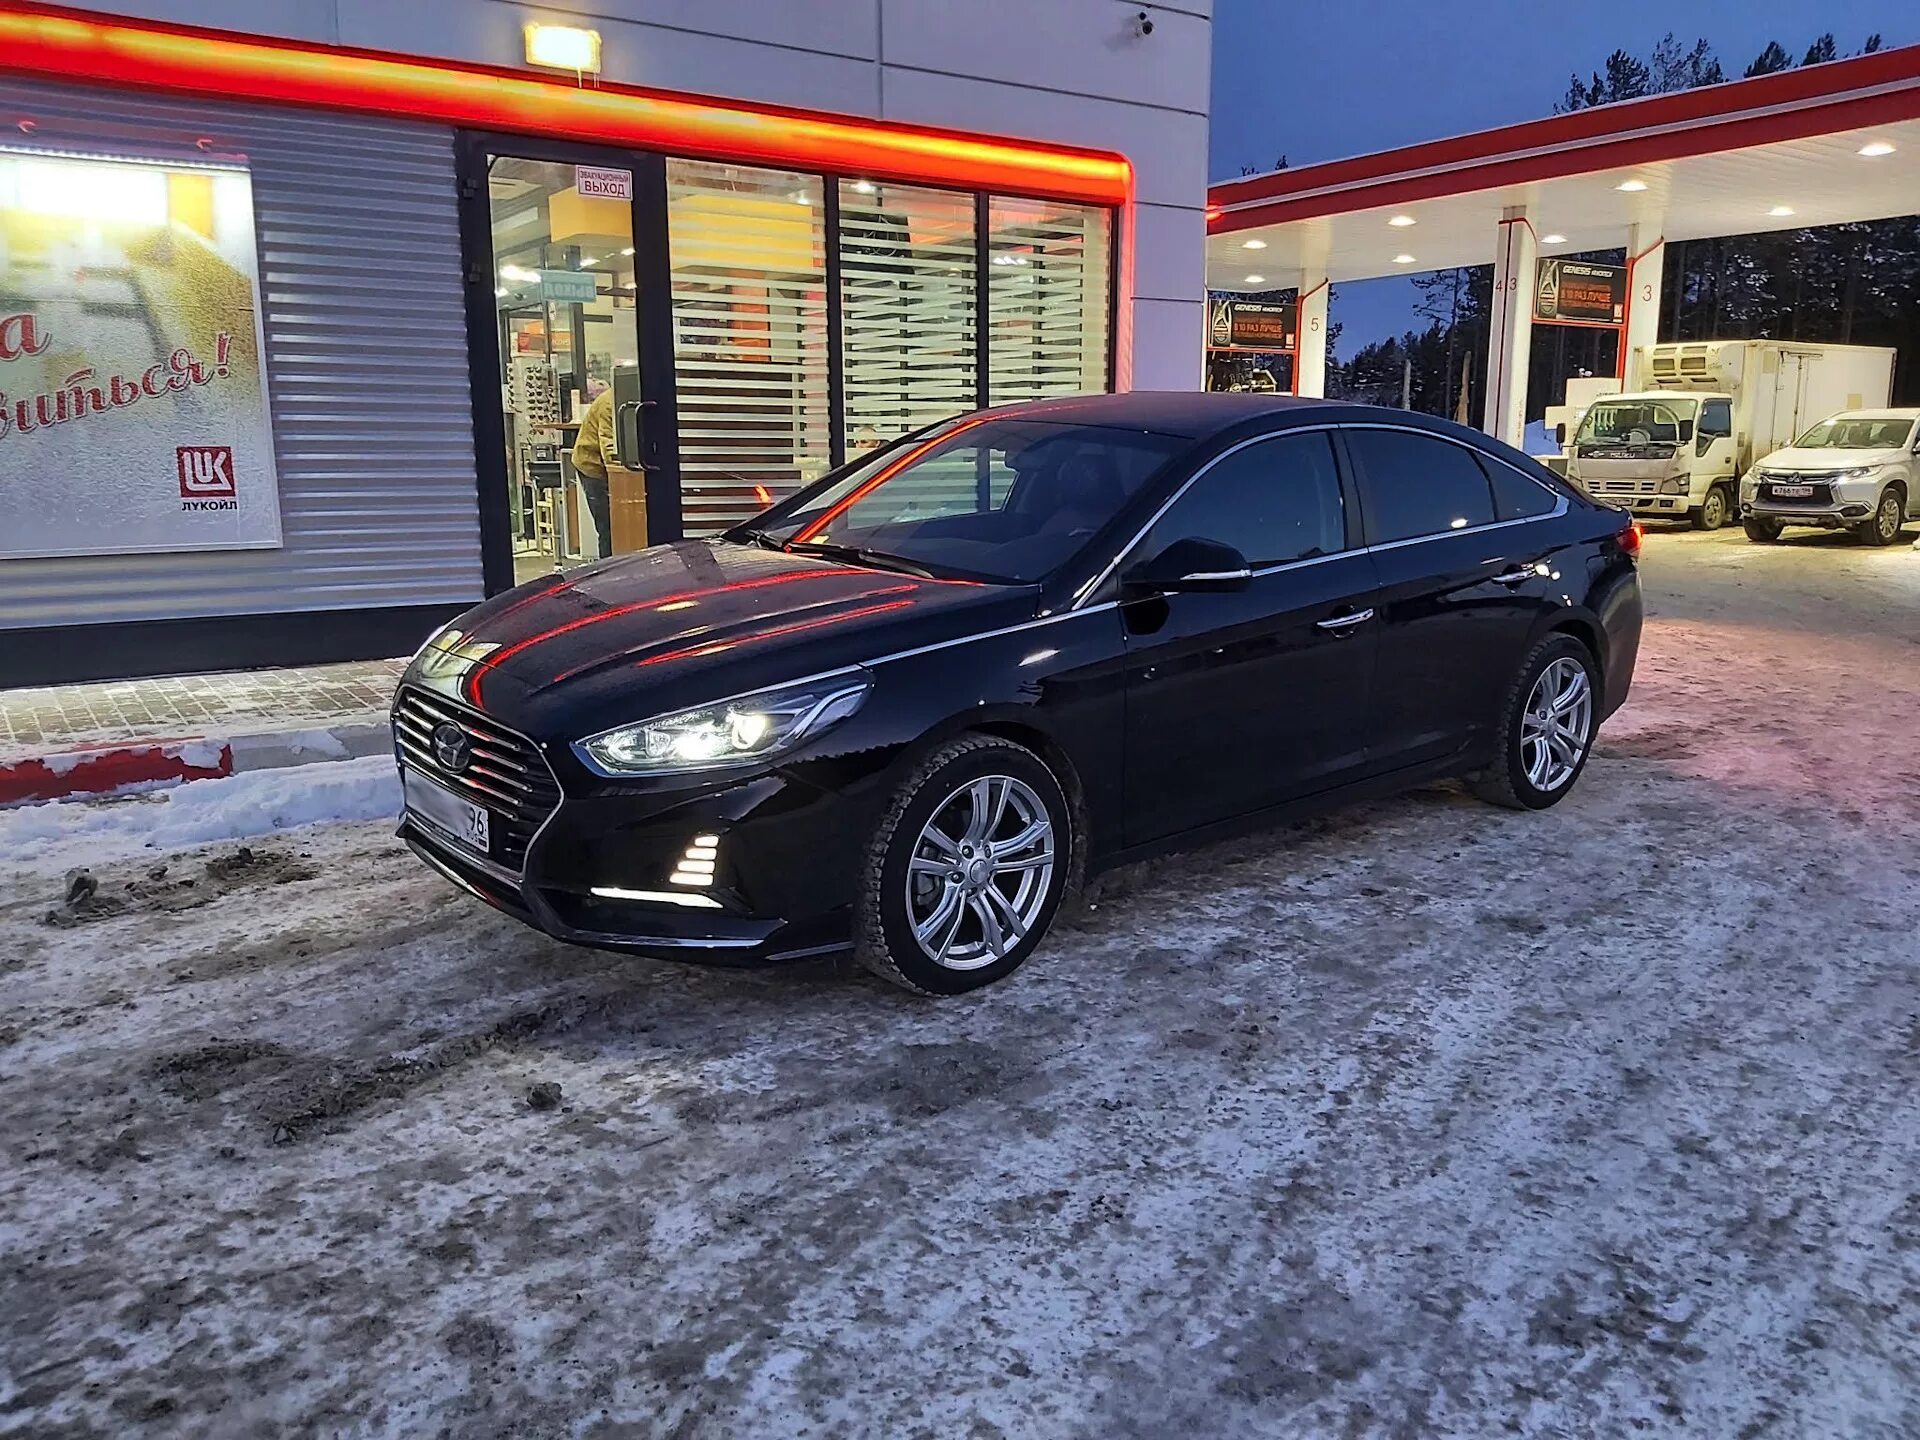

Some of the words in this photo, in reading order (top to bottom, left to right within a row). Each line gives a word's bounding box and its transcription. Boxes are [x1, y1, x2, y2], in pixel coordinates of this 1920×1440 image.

[580, 170, 629, 183] ЭВАКУАЦИОННЫЙ
[584, 180, 625, 197] ВЫХОД
[1495, 280, 1503, 292] 4
[1509, 278, 1517, 291] 3
[1642, 284, 1652, 302] 3
[1310, 317, 1319, 331] 5
[182, 500, 238, 511] ЛУКОЙЛ
